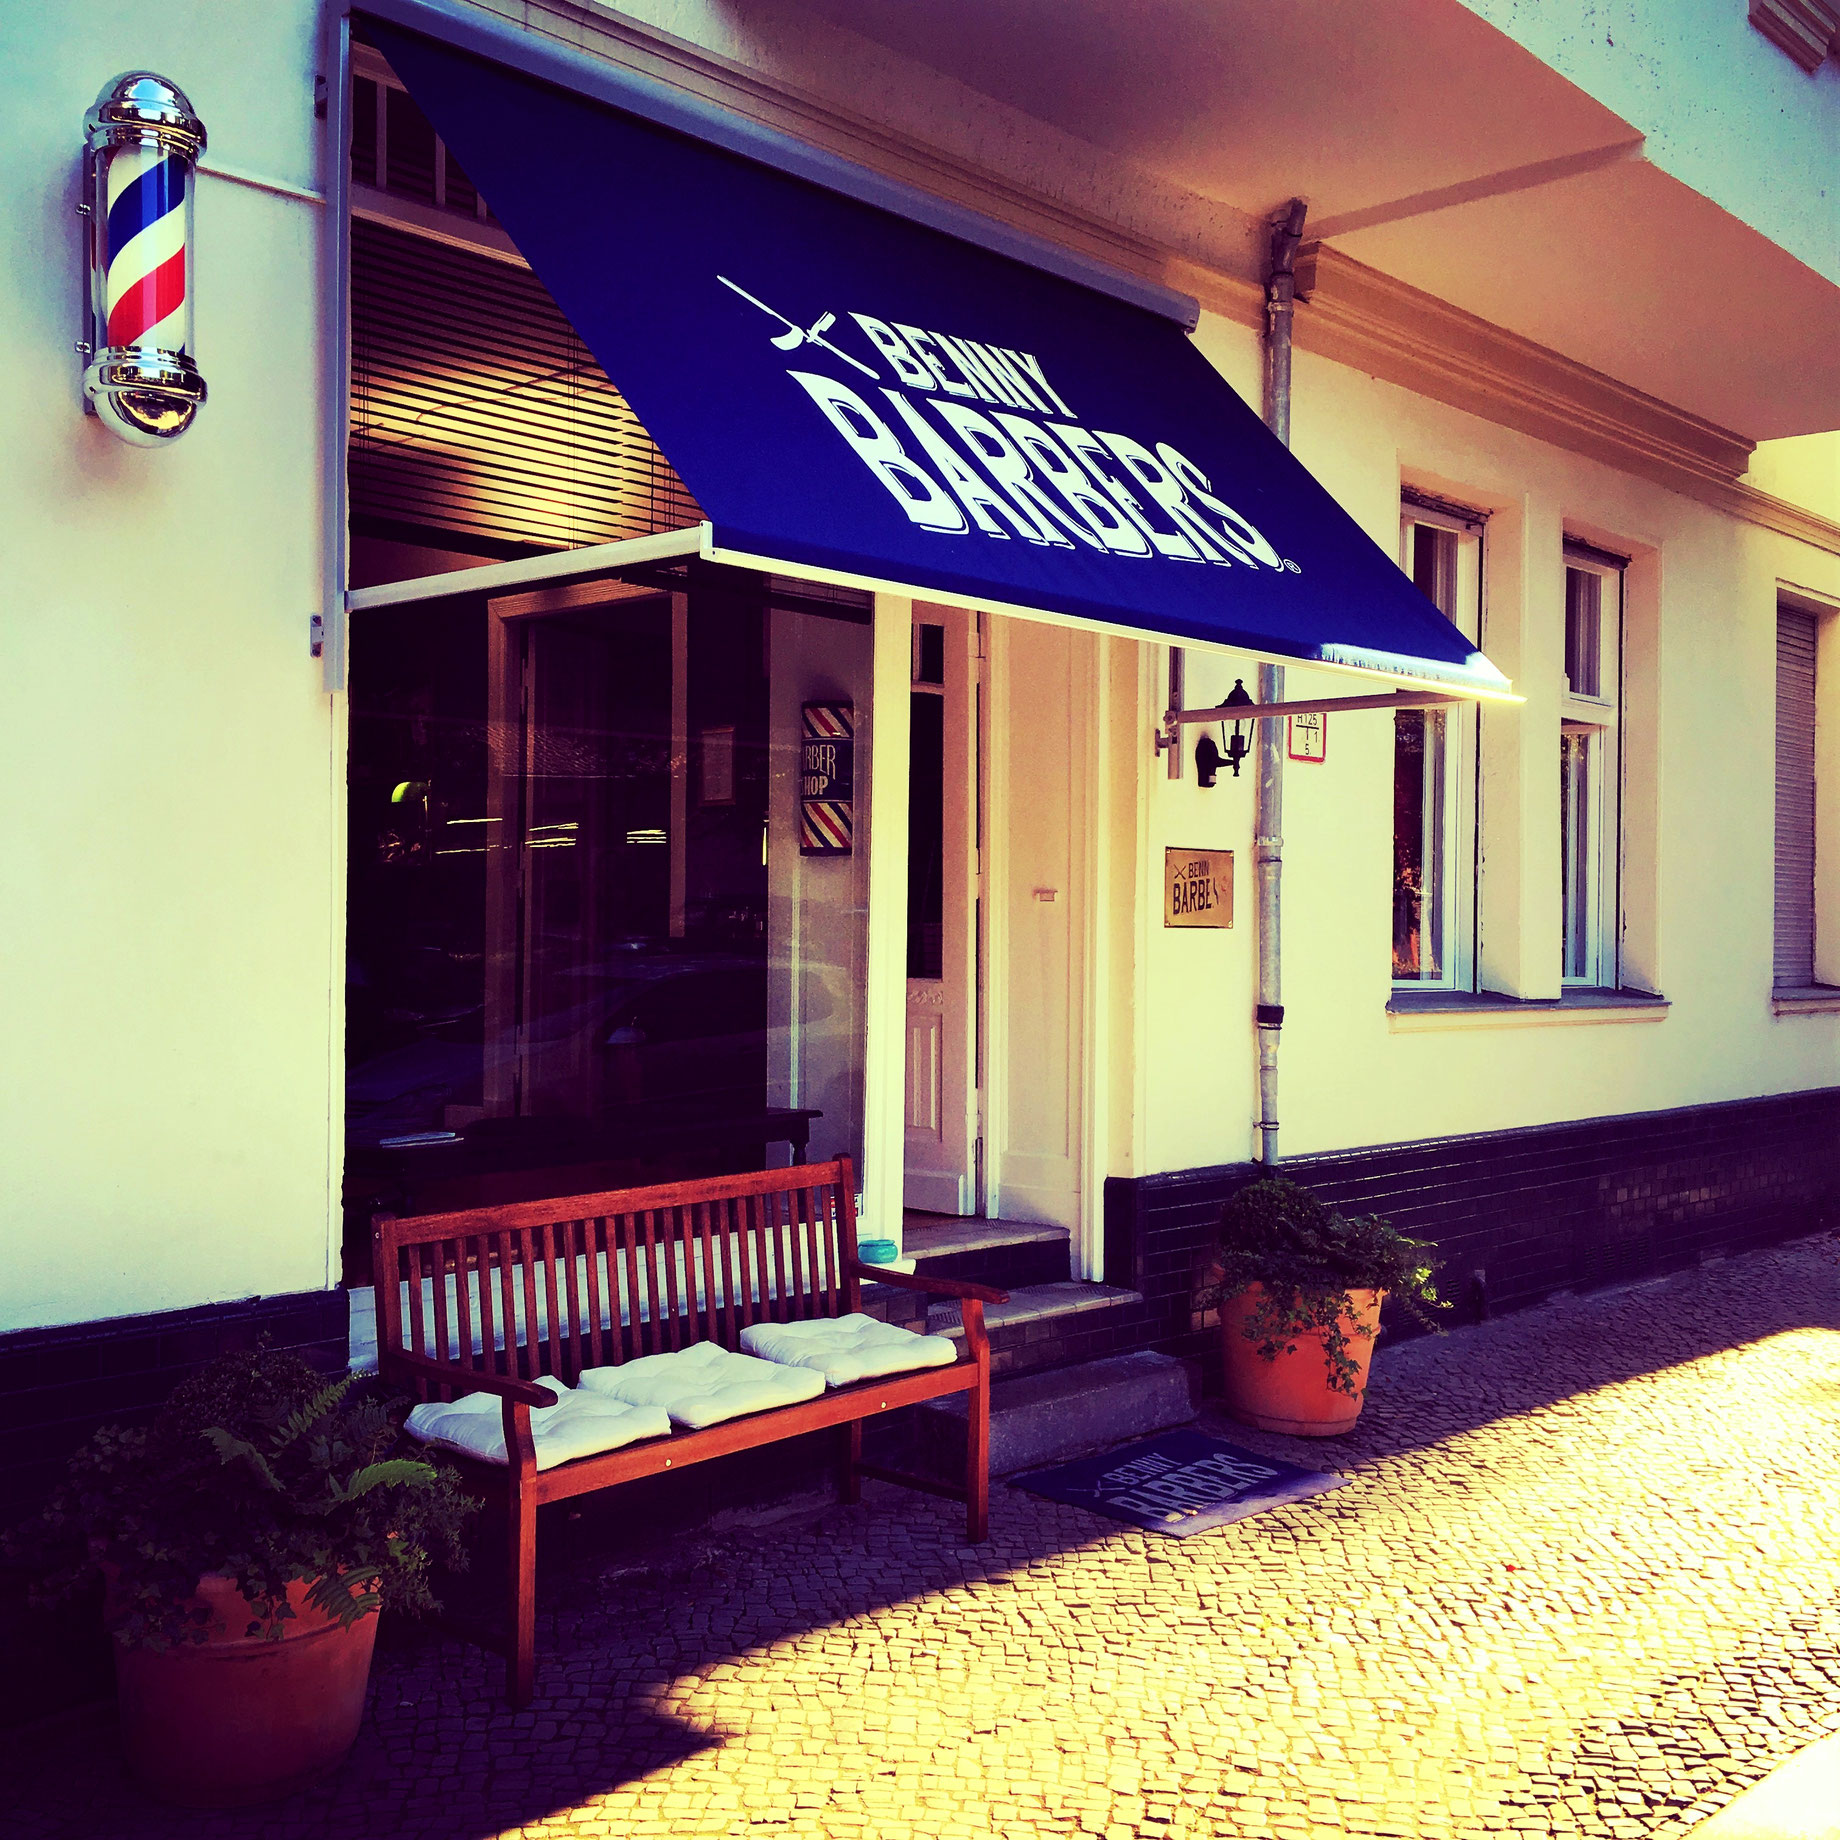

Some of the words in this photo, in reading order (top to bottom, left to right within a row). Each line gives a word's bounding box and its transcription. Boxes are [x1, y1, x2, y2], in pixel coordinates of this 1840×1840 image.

[847, 311, 1078, 419] BENNY
[802, 744, 836, 780] RBER
[1188, 859, 1210, 879] BENN
[1102, 1452, 1183, 1485] BENNY
[1106, 1453, 1279, 1523] BARBERS
